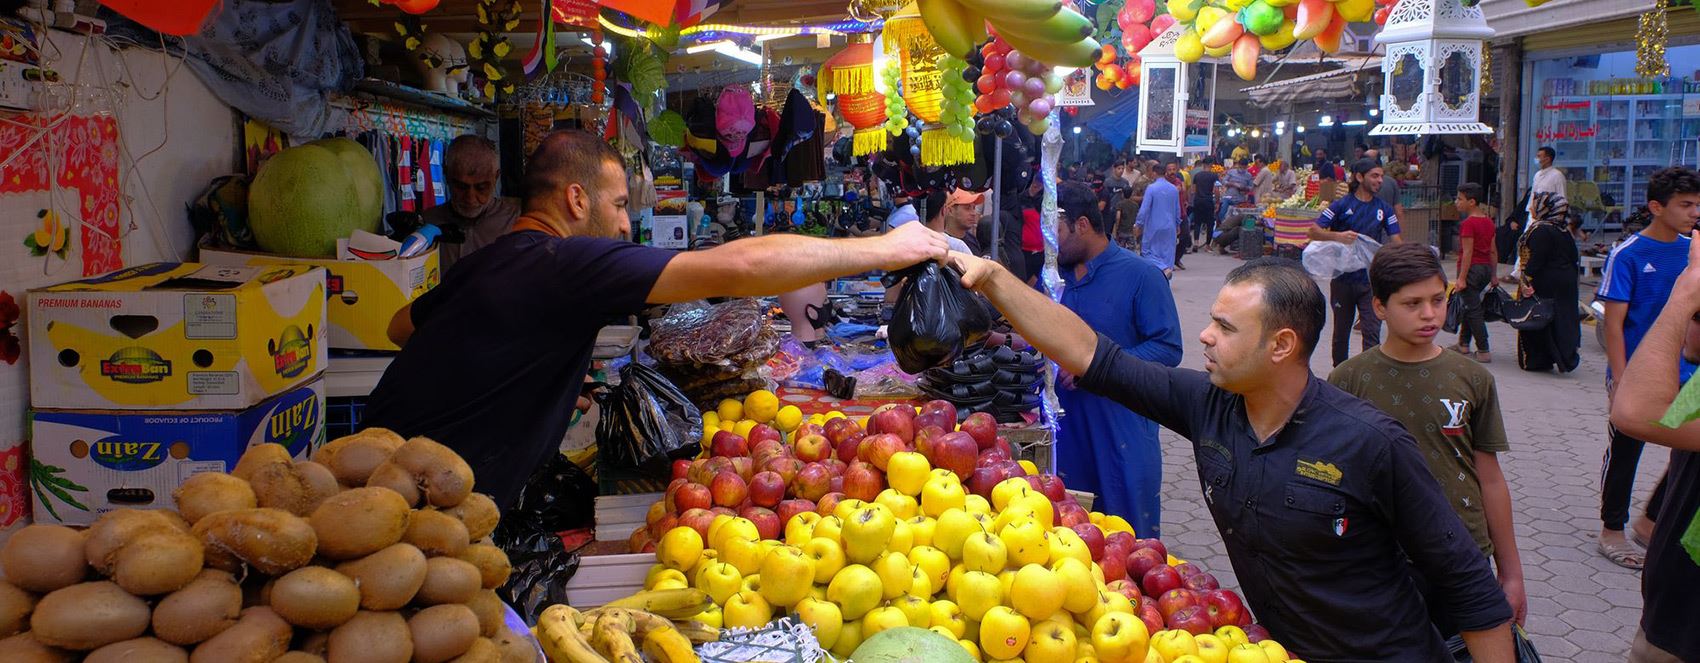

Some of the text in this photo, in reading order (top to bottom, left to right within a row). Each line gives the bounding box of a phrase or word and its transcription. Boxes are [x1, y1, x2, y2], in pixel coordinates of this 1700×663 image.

[1376, 209, 1384, 221] 8
[38, 298, 122, 309] PREMIUM BANANAS
[144, 416, 223, 424] PRODUCT OF ECUADOR
[271, 395, 316, 439] Zain
[97, 441, 161, 460] Zain
